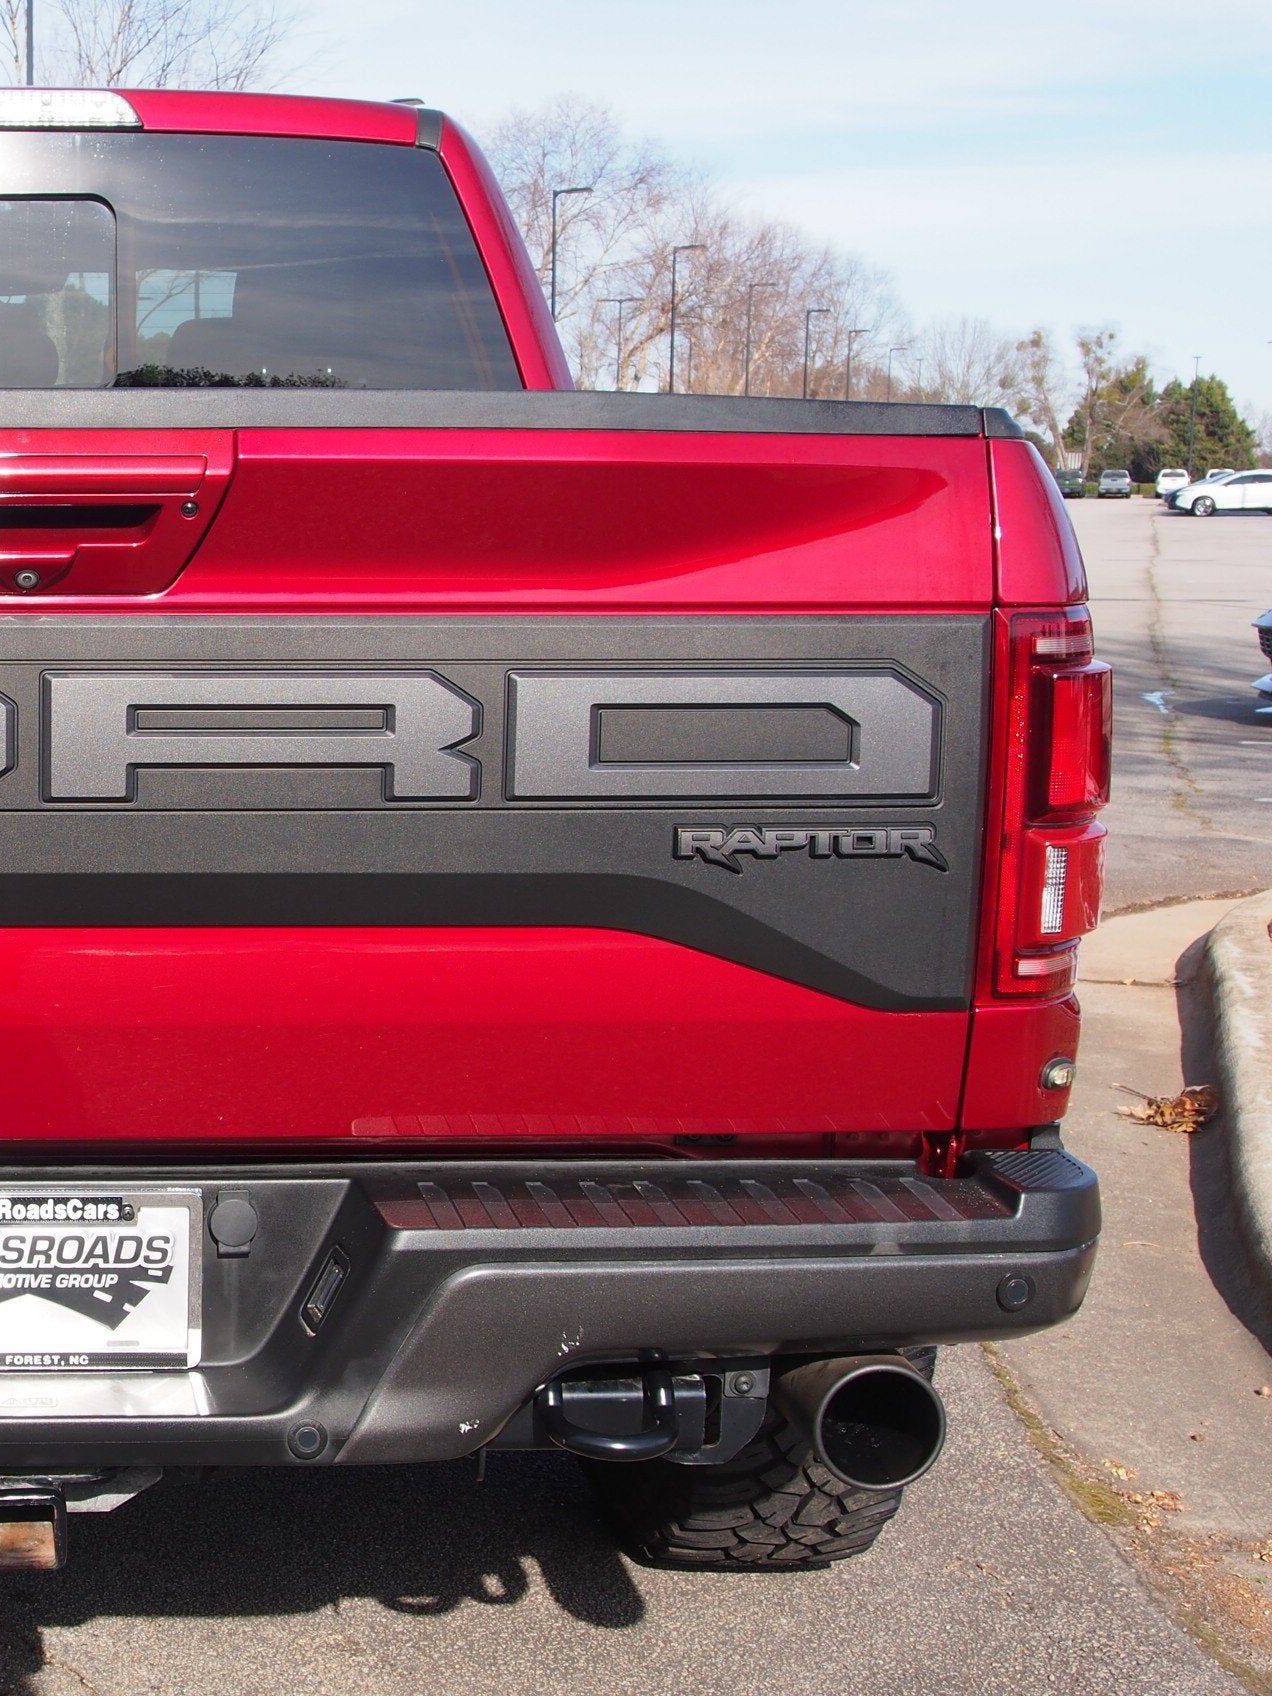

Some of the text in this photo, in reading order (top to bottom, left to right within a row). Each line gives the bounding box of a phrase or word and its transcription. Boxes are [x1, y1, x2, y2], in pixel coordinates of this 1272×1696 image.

[673, 823, 949, 875] RAPTOR
[55, 1273, 119, 1288] GROUP
[5, 1355, 65, 1368] FOREST,
[69, 1355, 89, 1365] NC
